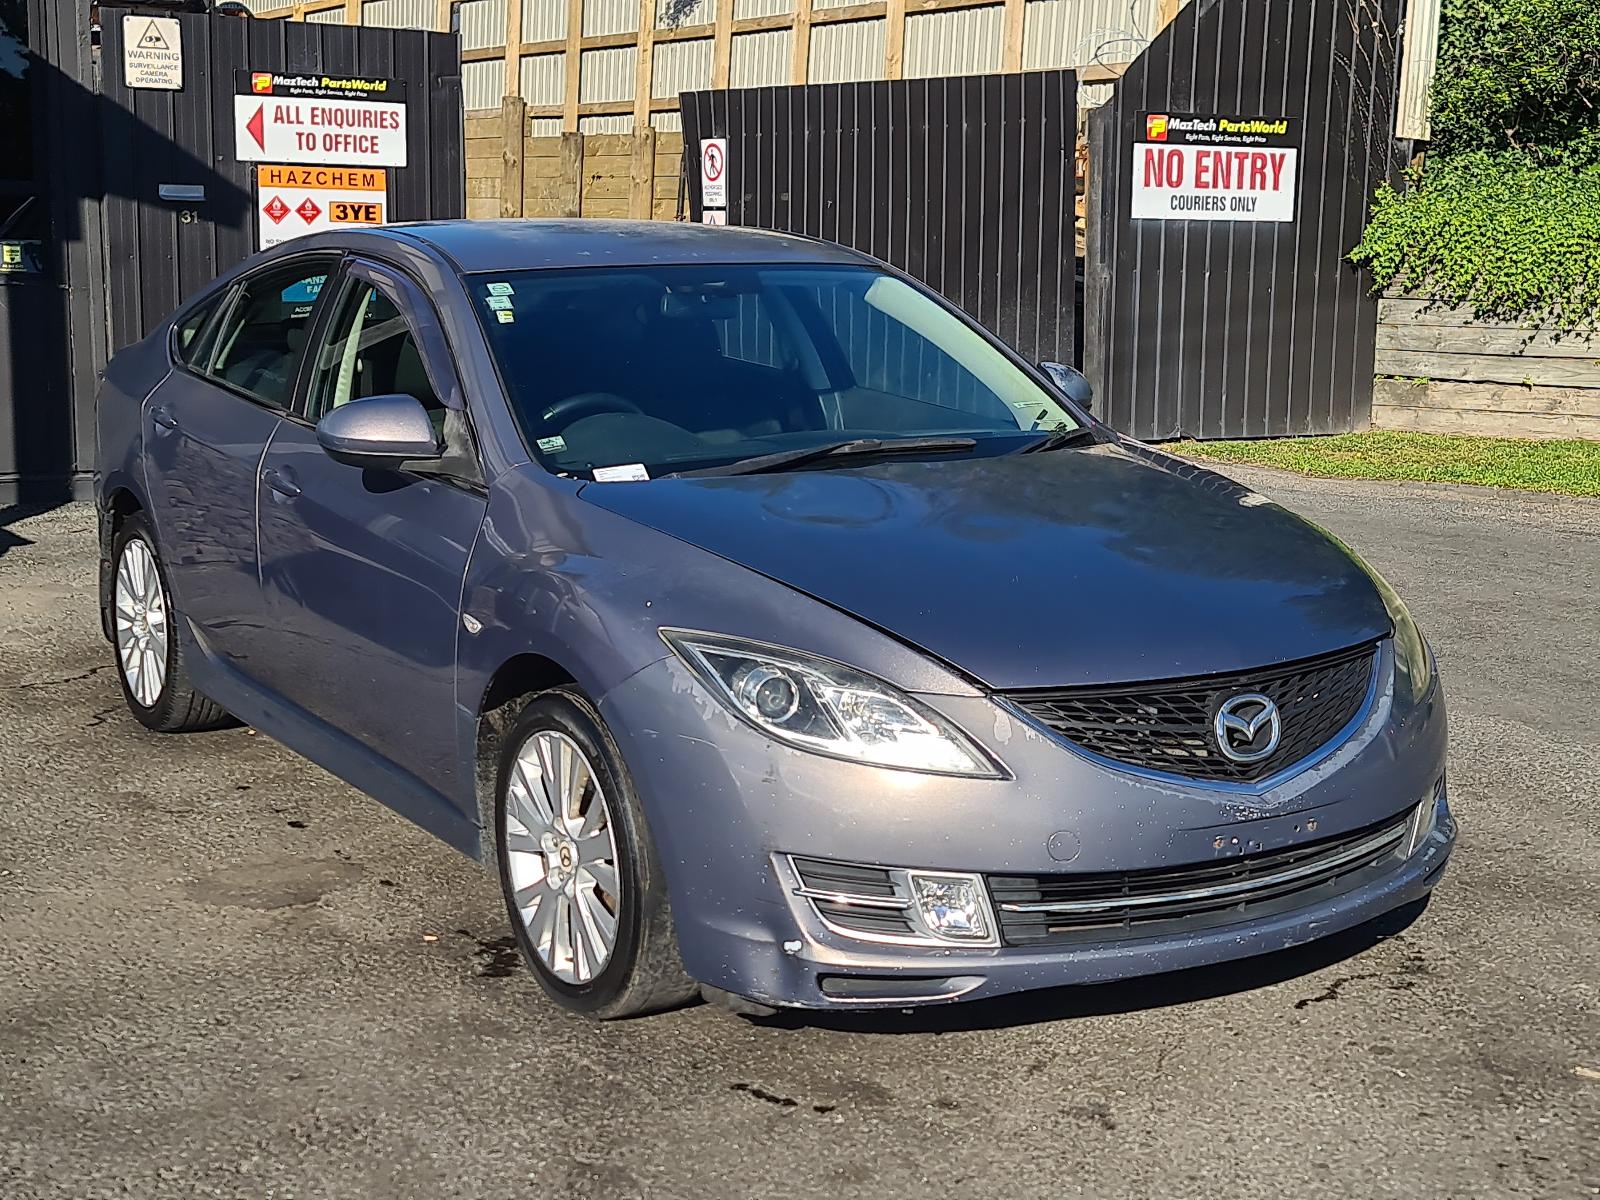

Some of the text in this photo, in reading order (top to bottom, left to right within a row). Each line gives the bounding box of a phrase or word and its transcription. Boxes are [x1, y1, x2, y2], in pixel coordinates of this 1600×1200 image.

[128, 50, 180, 61] WARNING
[129, 62, 179, 70] SURVEILLANCE
[272, 76, 387, 91] MazTech PartsWorld
[274, 105, 400, 129] ALL ENQUIRIES
[1168, 118, 1287, 134] MazTech PartsWorld
[296, 132, 379, 154] TO OFFICE
[1144, 148, 1286, 191] NO ENTRY
[270, 170, 375, 186] HAZCHEM
[1170, 194, 1257, 212] COURIERS ONLY
[180, 210, 198, 224] 31
[336, 204, 376, 221] 3YE
